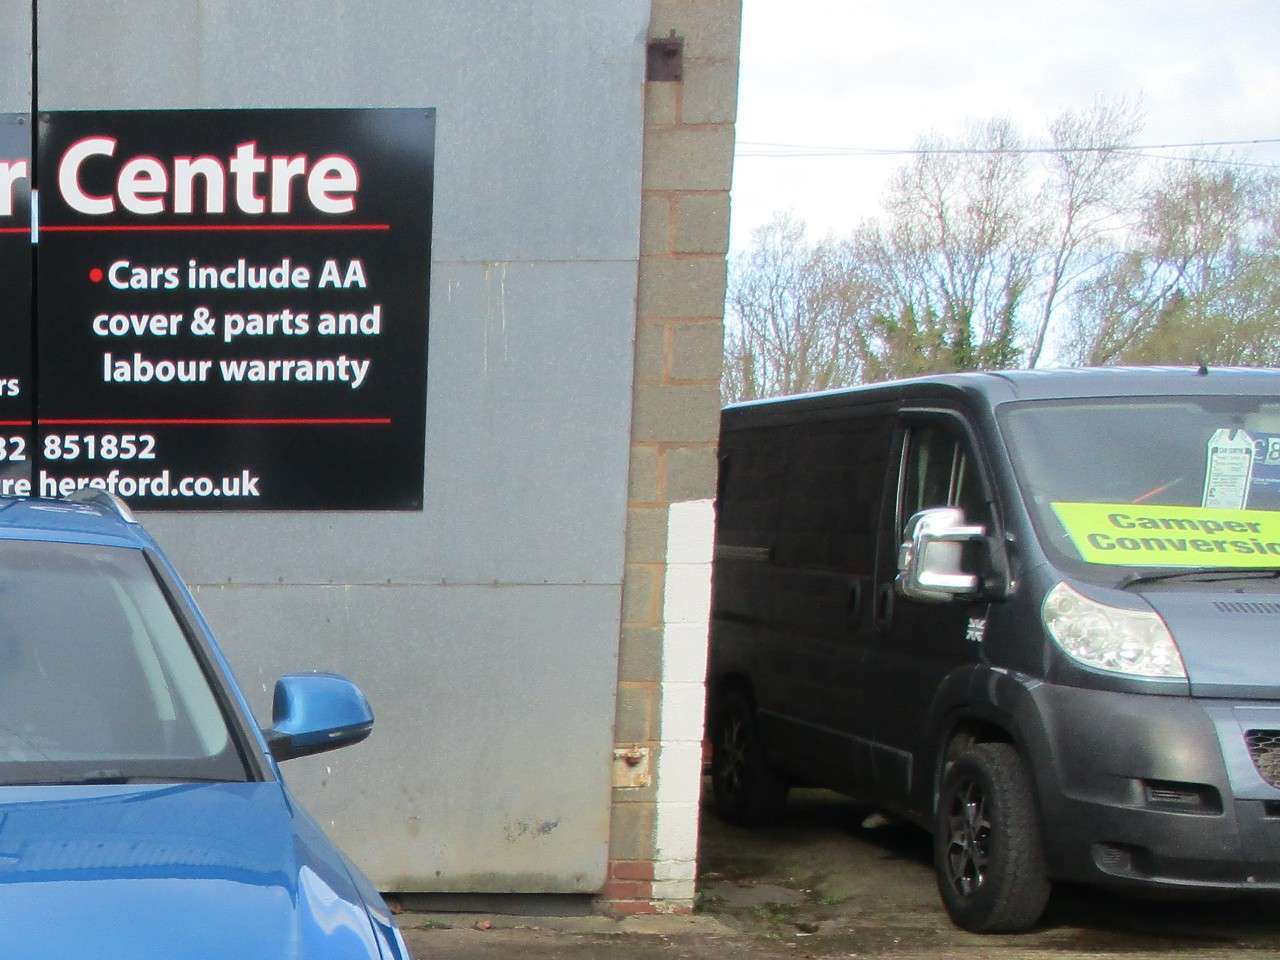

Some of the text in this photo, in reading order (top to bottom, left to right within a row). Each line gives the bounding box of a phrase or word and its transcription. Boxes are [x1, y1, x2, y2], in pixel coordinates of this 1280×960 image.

[58, 134, 360, 216] Centre
[107, 258, 367, 289] Cars include AA
[92, 304, 381, 343] cover & parts and
[103, 352, 371, 390] labour warranty
[43, 434, 156, 460] 851852
[1107, 513, 1261, 534] Camper
